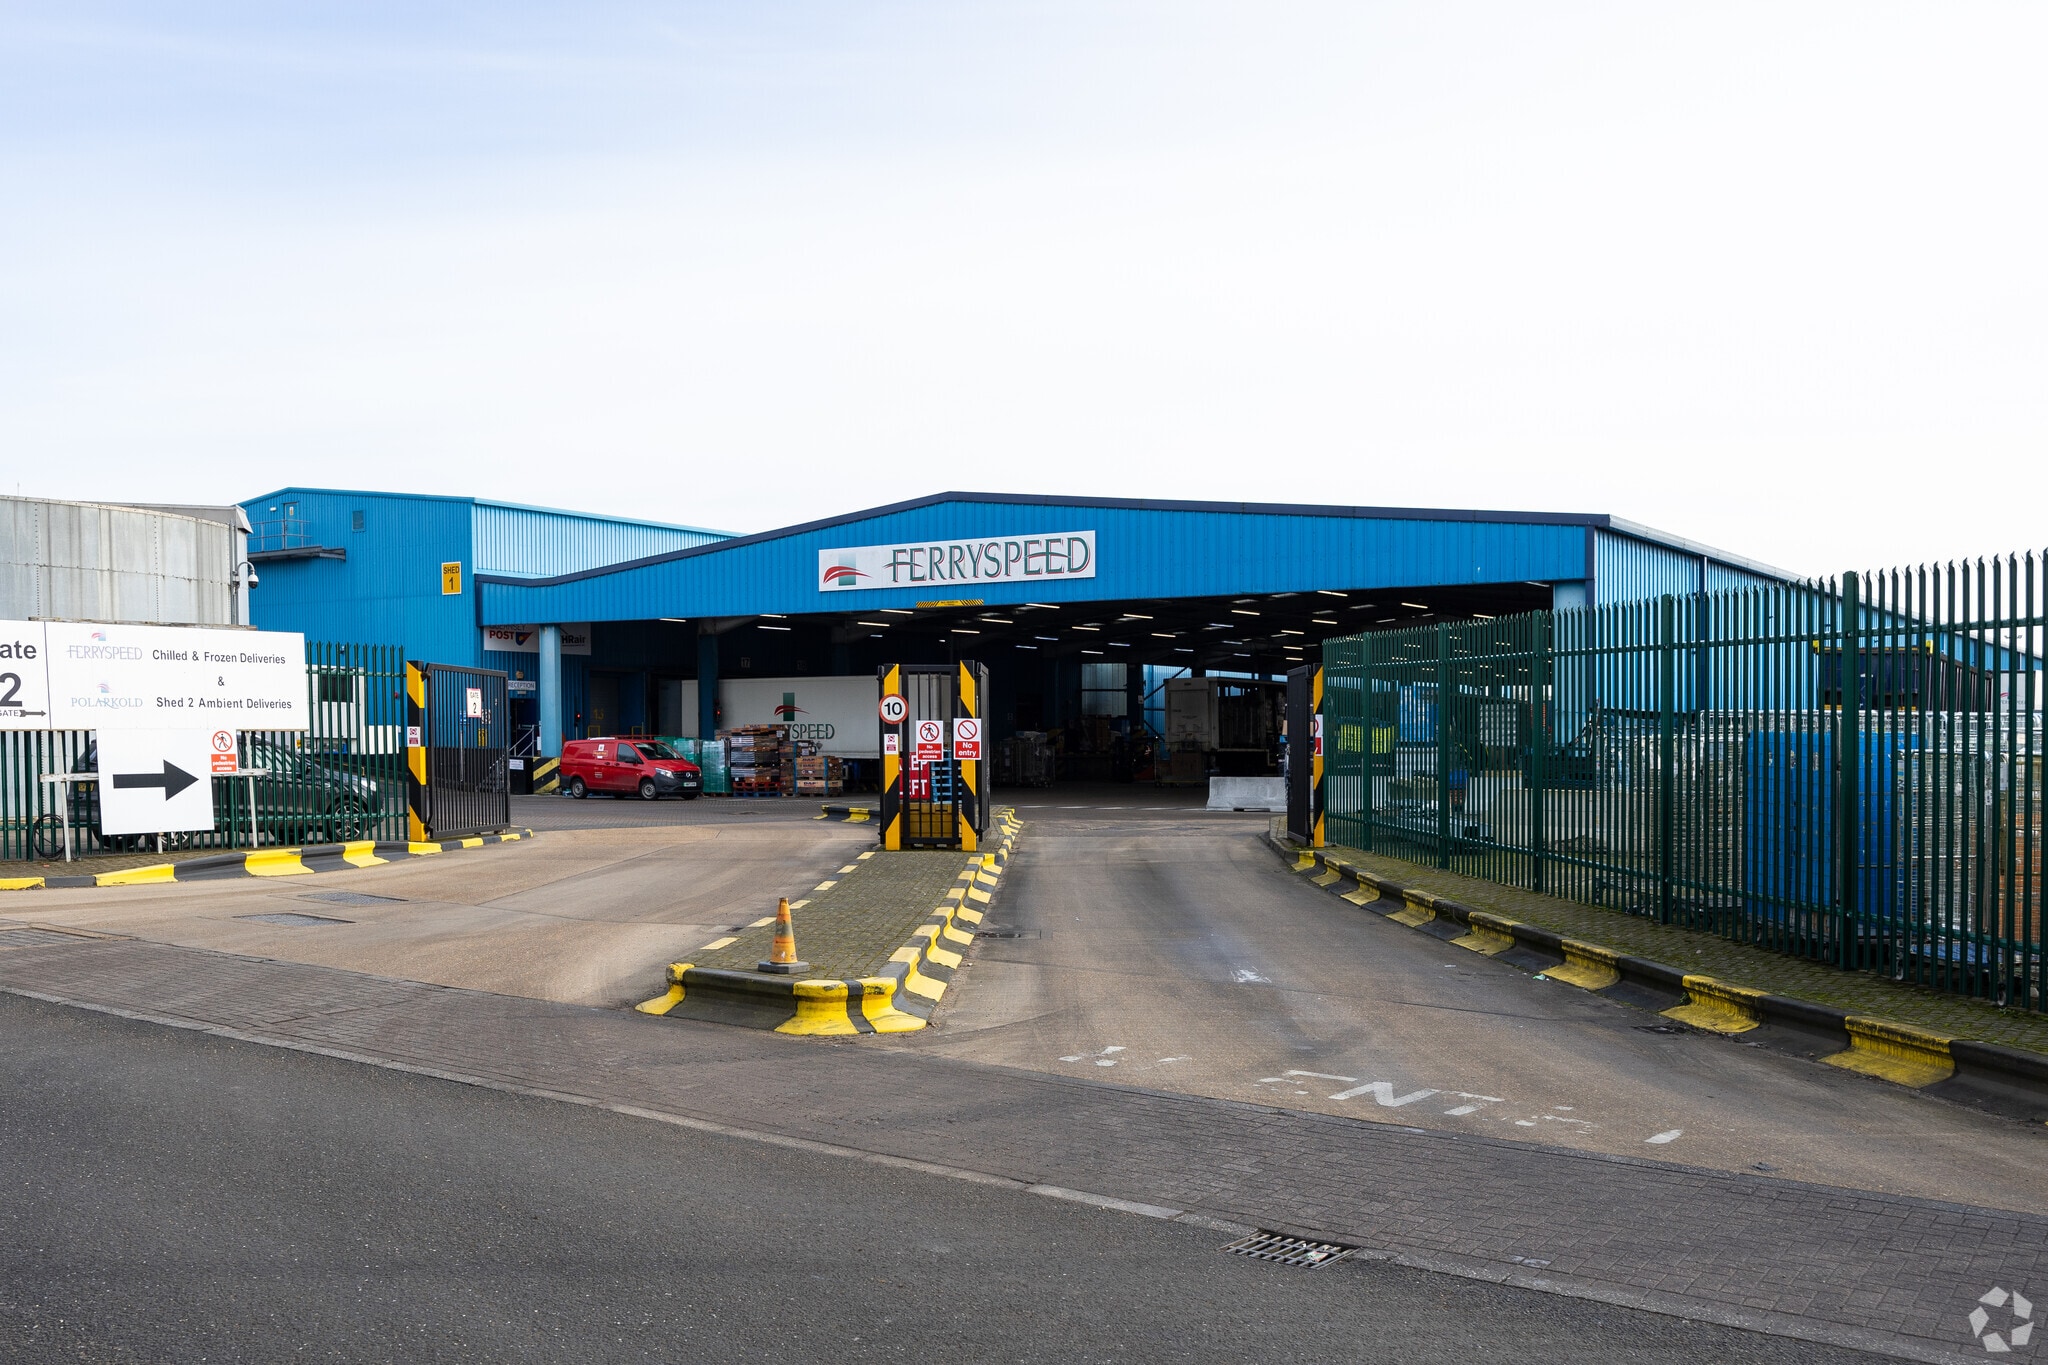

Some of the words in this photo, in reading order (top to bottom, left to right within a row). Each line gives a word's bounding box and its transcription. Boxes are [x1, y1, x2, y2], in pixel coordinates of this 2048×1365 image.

[883, 536, 1091, 583] FERRYSPEED
[443, 565, 460, 574] SHED
[449, 576, 454, 590] 1
[489, 630, 514, 640] POST
[0, 640, 37, 660] ate
[67, 645, 143, 660] FERRYSPEED
[152, 649, 188, 661] Chilled
[192, 651, 200, 661] &
[204, 652, 237, 662] Frozen
[240, 653, 286, 664] Deliveries
[217, 676, 225, 686] &
[0, 672, 23, 707] 2
[470, 691, 479, 699] GATE
[71, 698, 143, 709] POLARKOLD
[156, 697, 184, 708] Shed
[188, 697, 194, 708] 2
[199, 698, 243, 709] Ambient
[246, 699, 292, 709] Deliveries
[473, 702, 477, 714] 2
[884, 702, 903, 716] 10
[791, 723, 835, 739] SPEED
[958, 749, 977, 757] entry
